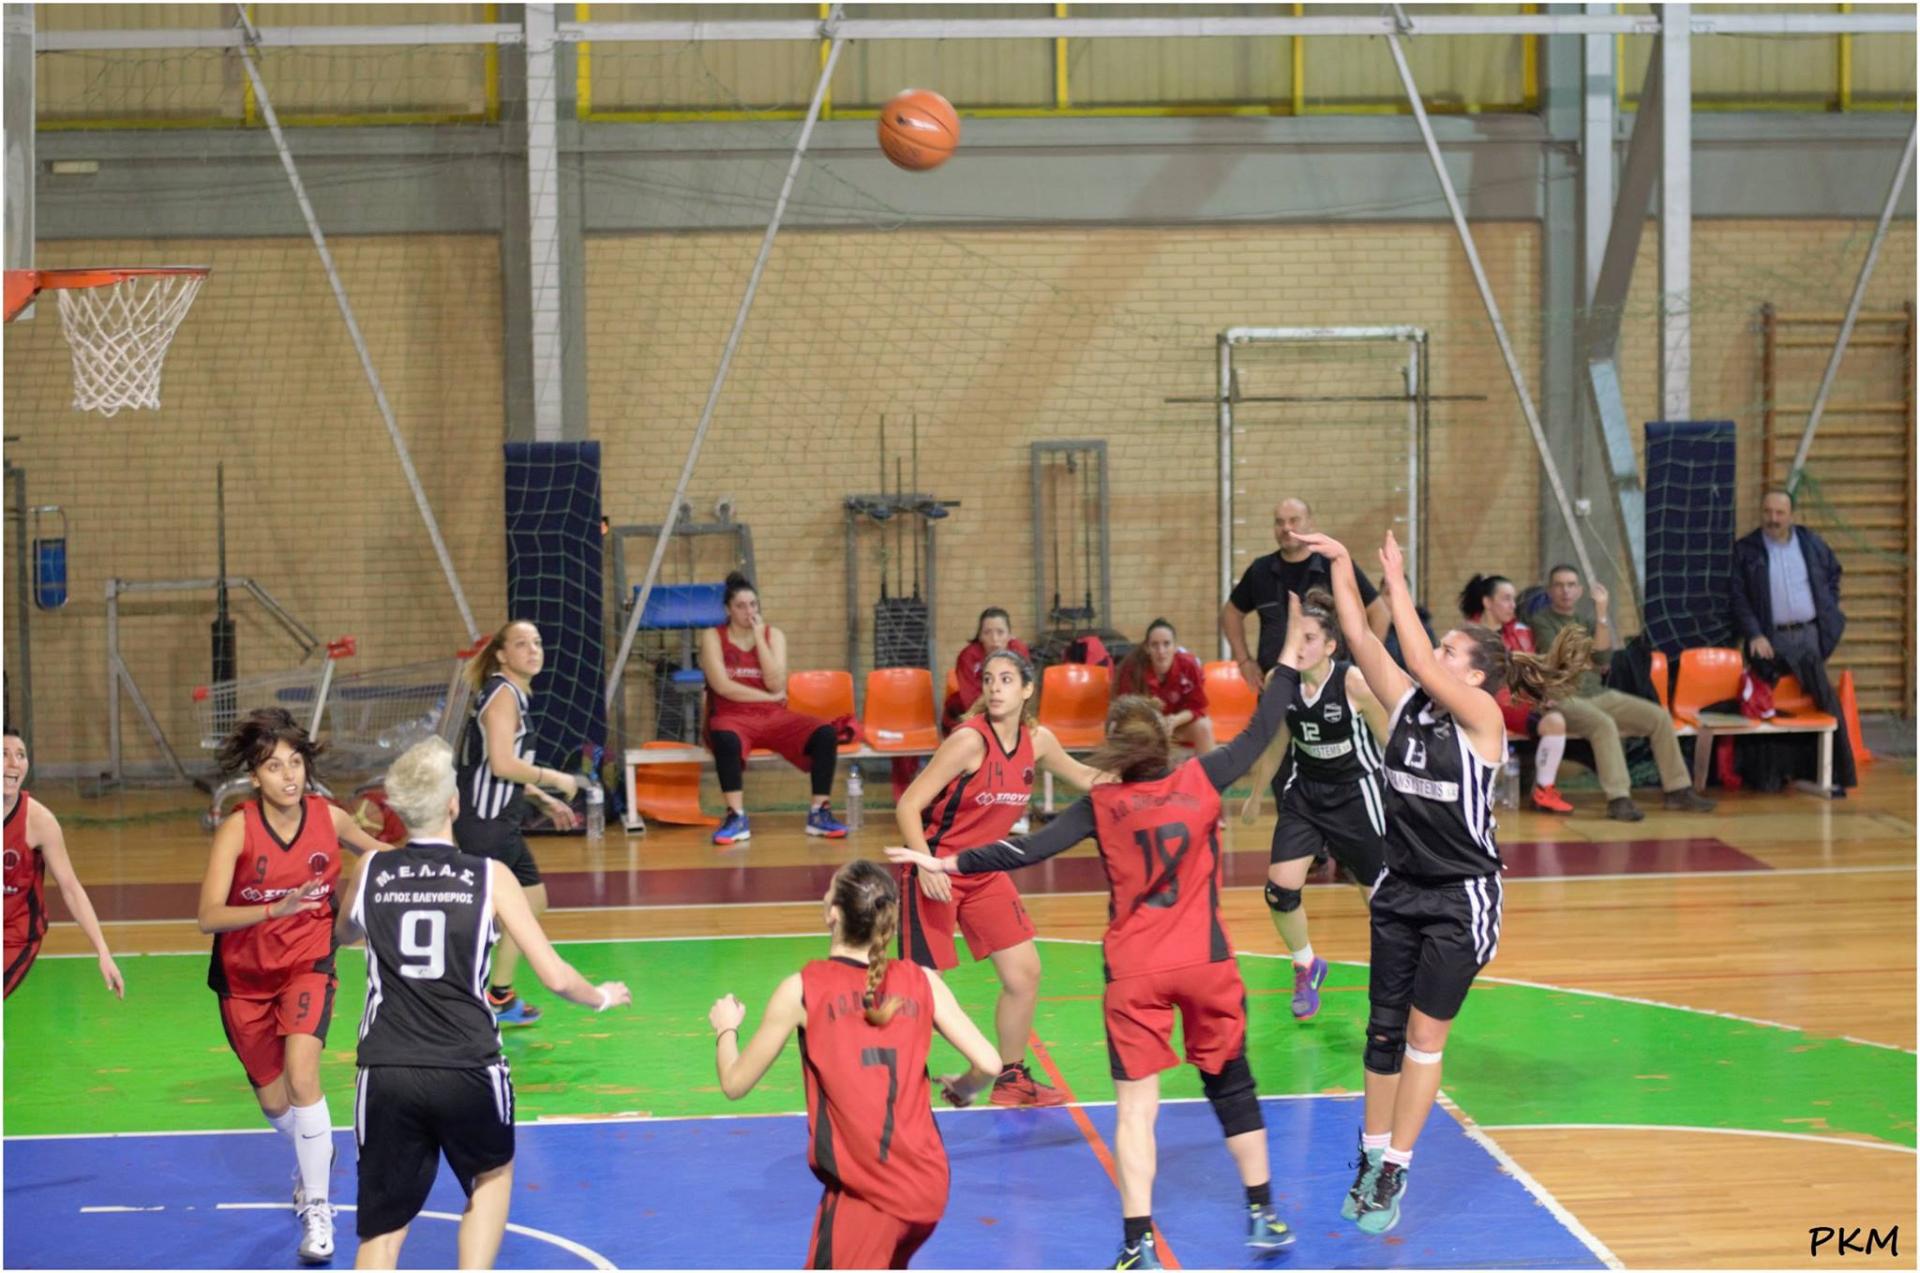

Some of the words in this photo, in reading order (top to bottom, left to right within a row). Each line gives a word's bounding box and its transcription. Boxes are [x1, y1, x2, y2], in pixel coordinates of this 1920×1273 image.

[1300, 721, 1321, 742] 12
[1132, 822, 1191, 909] 18
[400, 909, 447, 980] 9
[296, 991, 311, 1019] 9
[861, 1047, 898, 1164] 7
